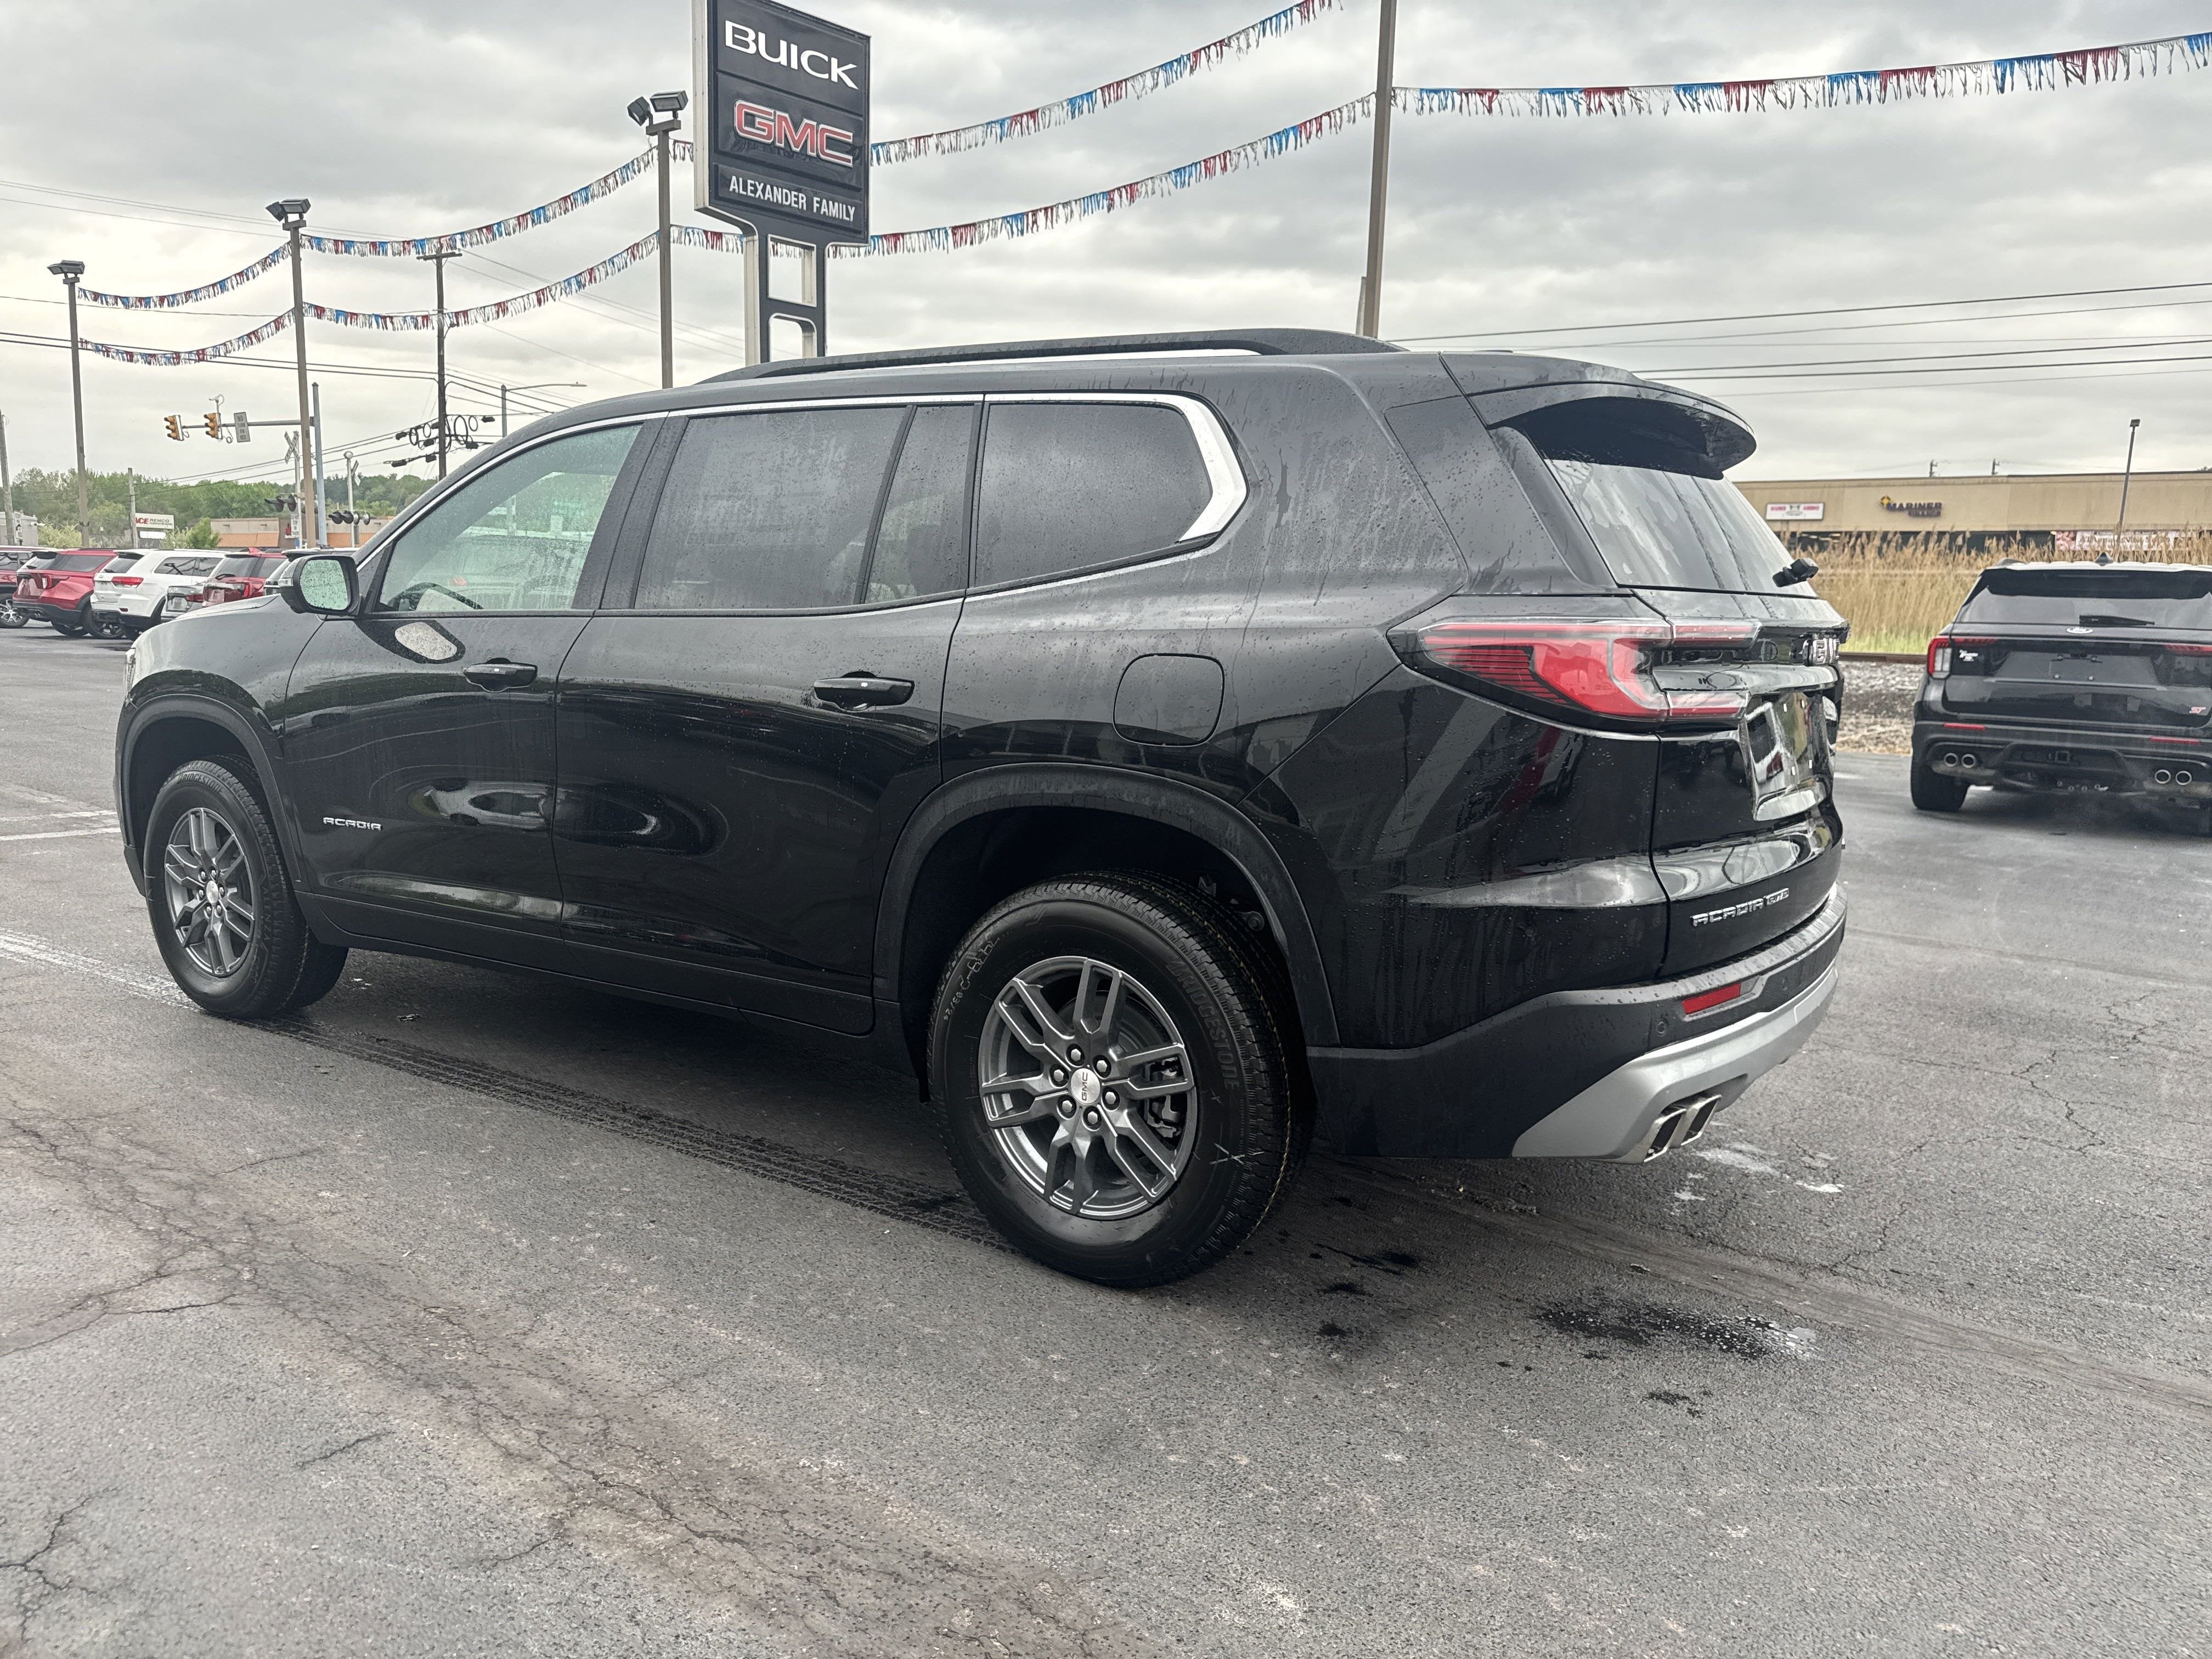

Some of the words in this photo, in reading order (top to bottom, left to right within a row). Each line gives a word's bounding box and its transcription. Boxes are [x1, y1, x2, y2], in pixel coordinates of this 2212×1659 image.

[725, 20, 859, 90] BUICK
[735, 100, 854, 168] GMC
[729, 176, 806, 211] ALEXANDER
[813, 196, 855, 223] FAMILY
[1887, 502, 1942, 511] MARINER
[323, 817, 382, 831] ACADIA
[1691, 898, 1764, 927] ACADIA
[1155, 959, 1240, 1091] BRIDGESTONE
